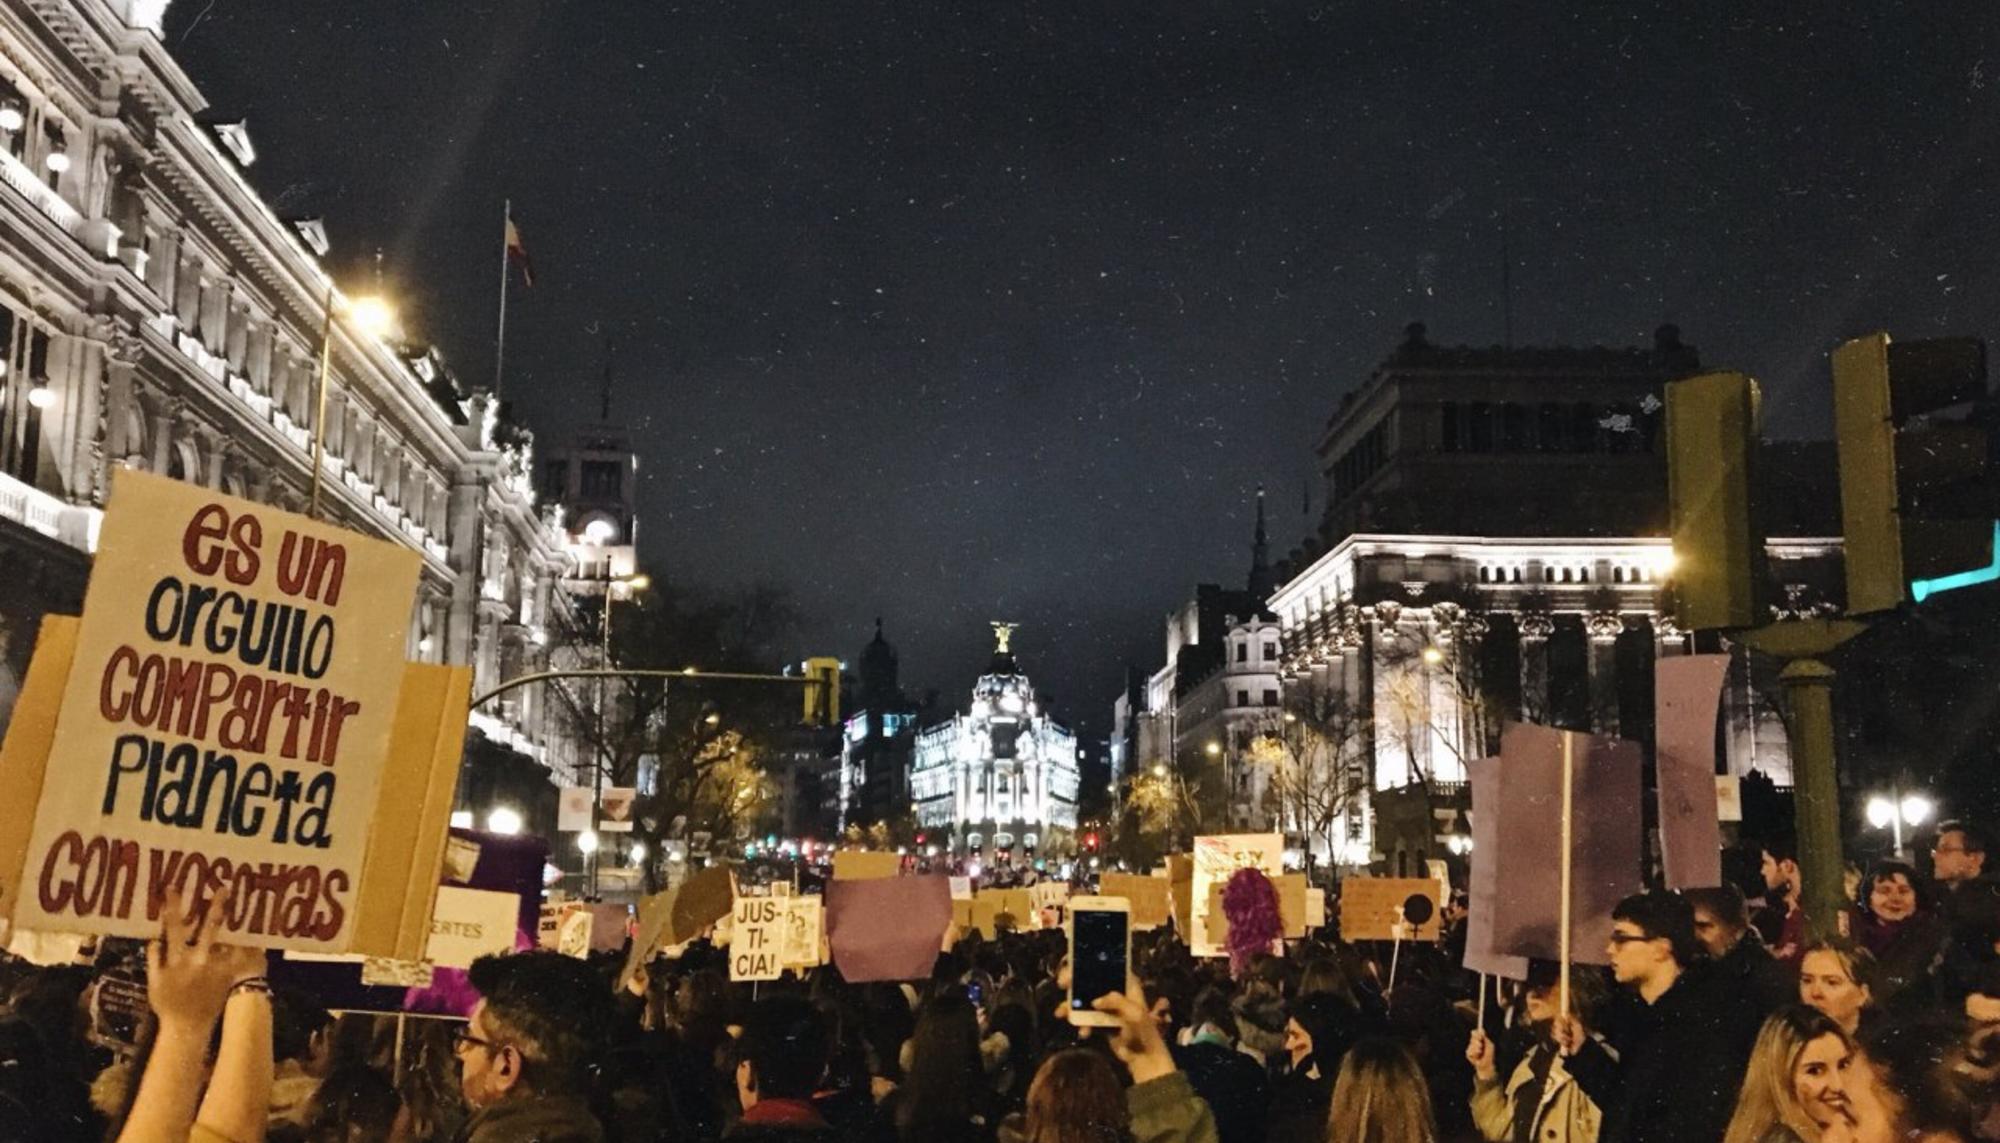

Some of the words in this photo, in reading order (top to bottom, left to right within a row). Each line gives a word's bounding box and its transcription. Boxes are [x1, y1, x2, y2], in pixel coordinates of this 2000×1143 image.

[182, 503, 262, 586] es
[277, 530, 346, 607] un
[737, 901, 782, 924] JUS-
[747, 927, 769, 949] TI-
[736, 953, 775, 976] CIA!
